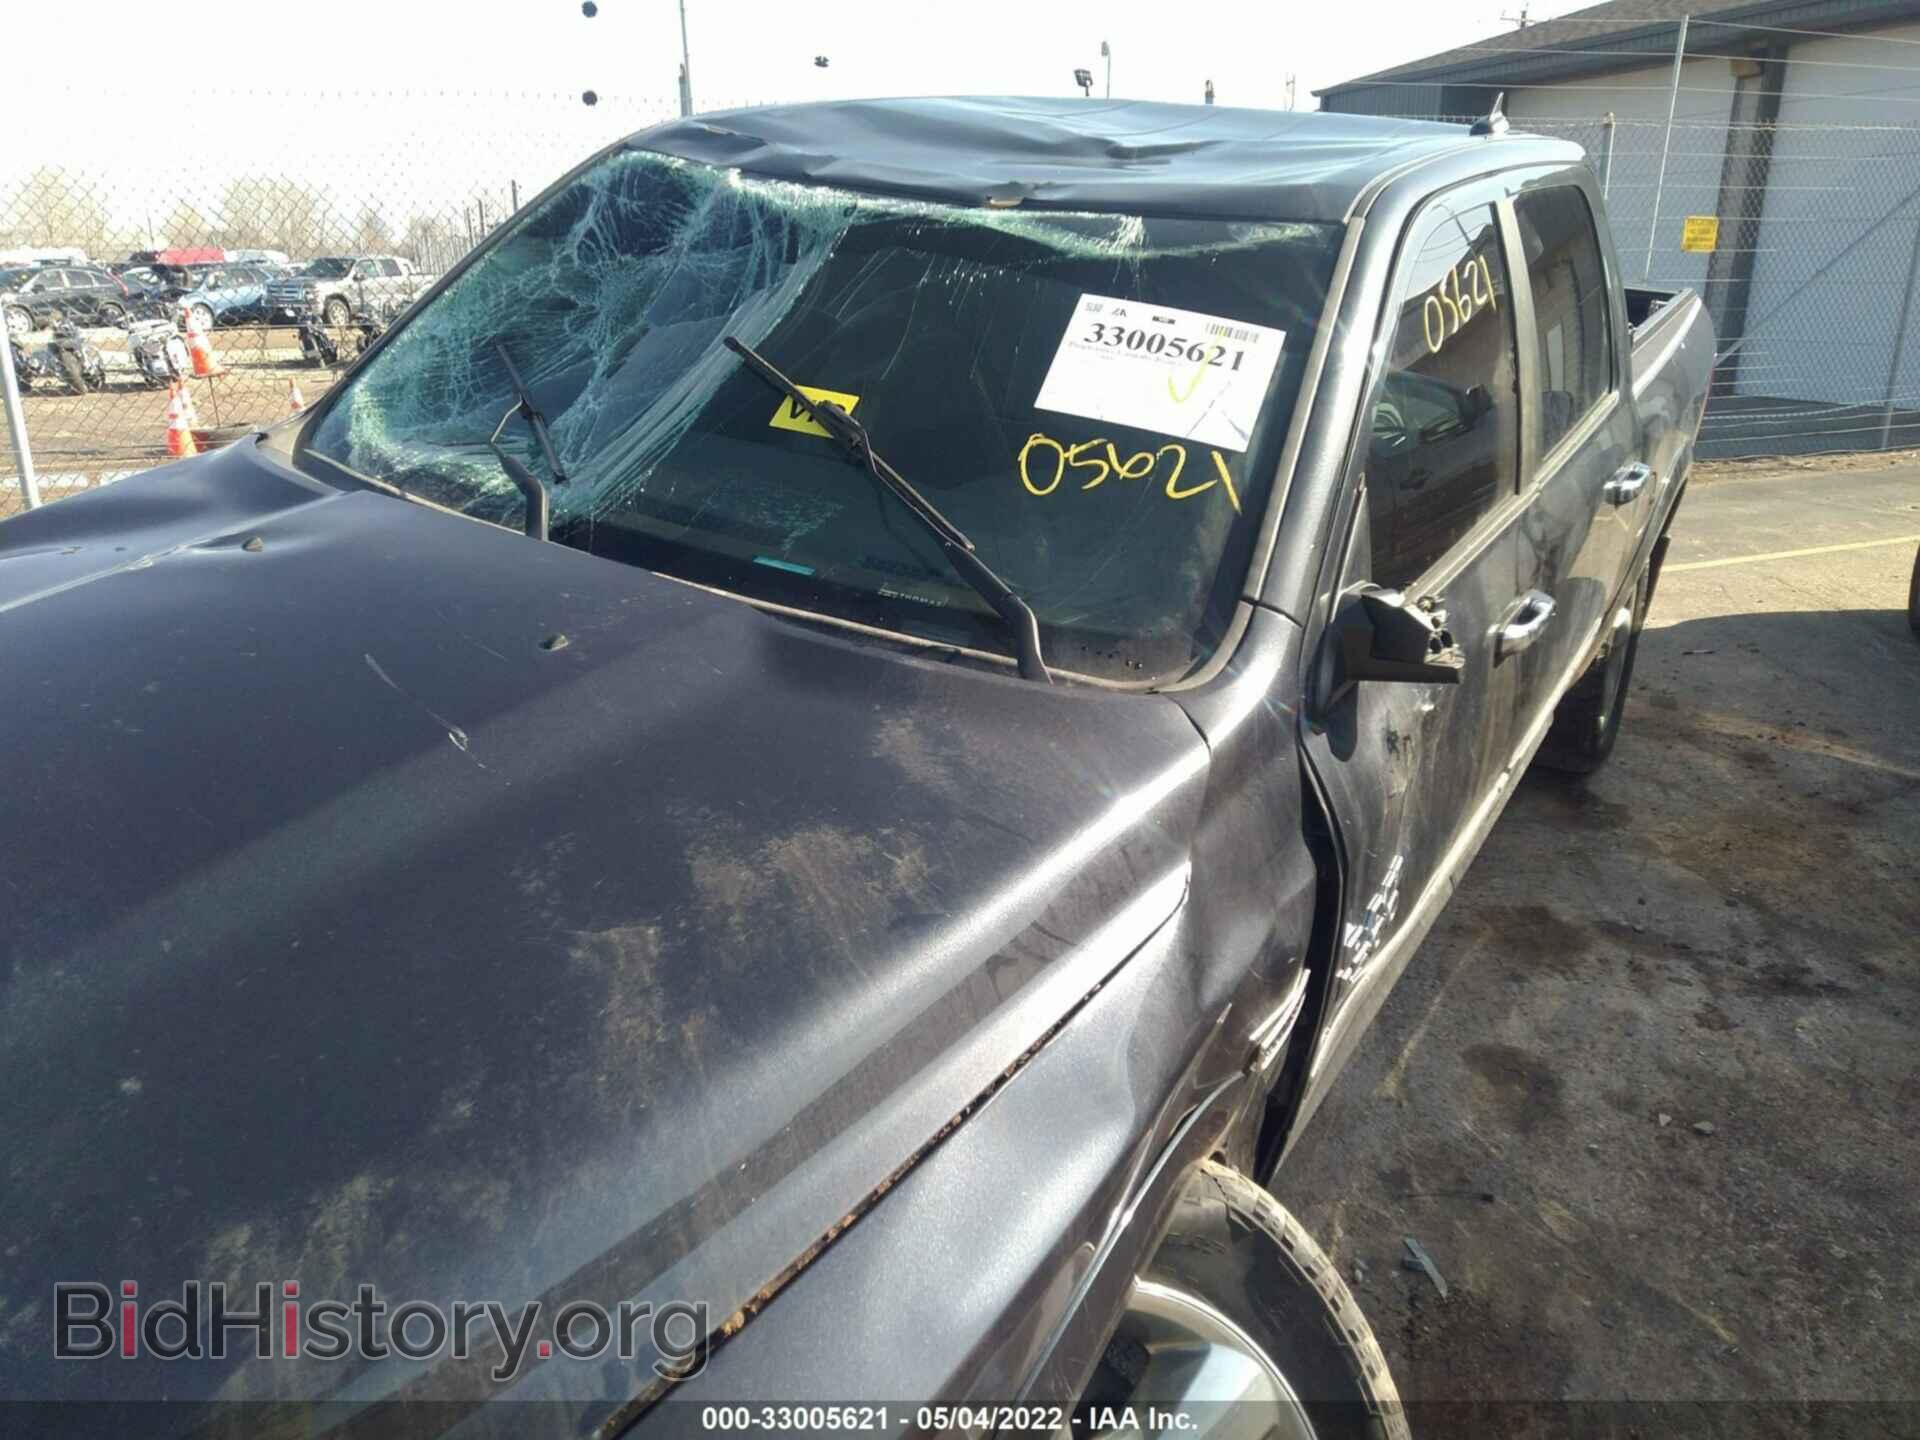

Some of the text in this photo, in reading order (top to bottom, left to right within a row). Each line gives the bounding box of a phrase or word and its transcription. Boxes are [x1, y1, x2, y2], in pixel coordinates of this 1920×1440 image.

[1424, 254, 1497, 354] 05621
[1083, 321, 1246, 373] 33005621
[1017, 431, 1243, 515] 05621
